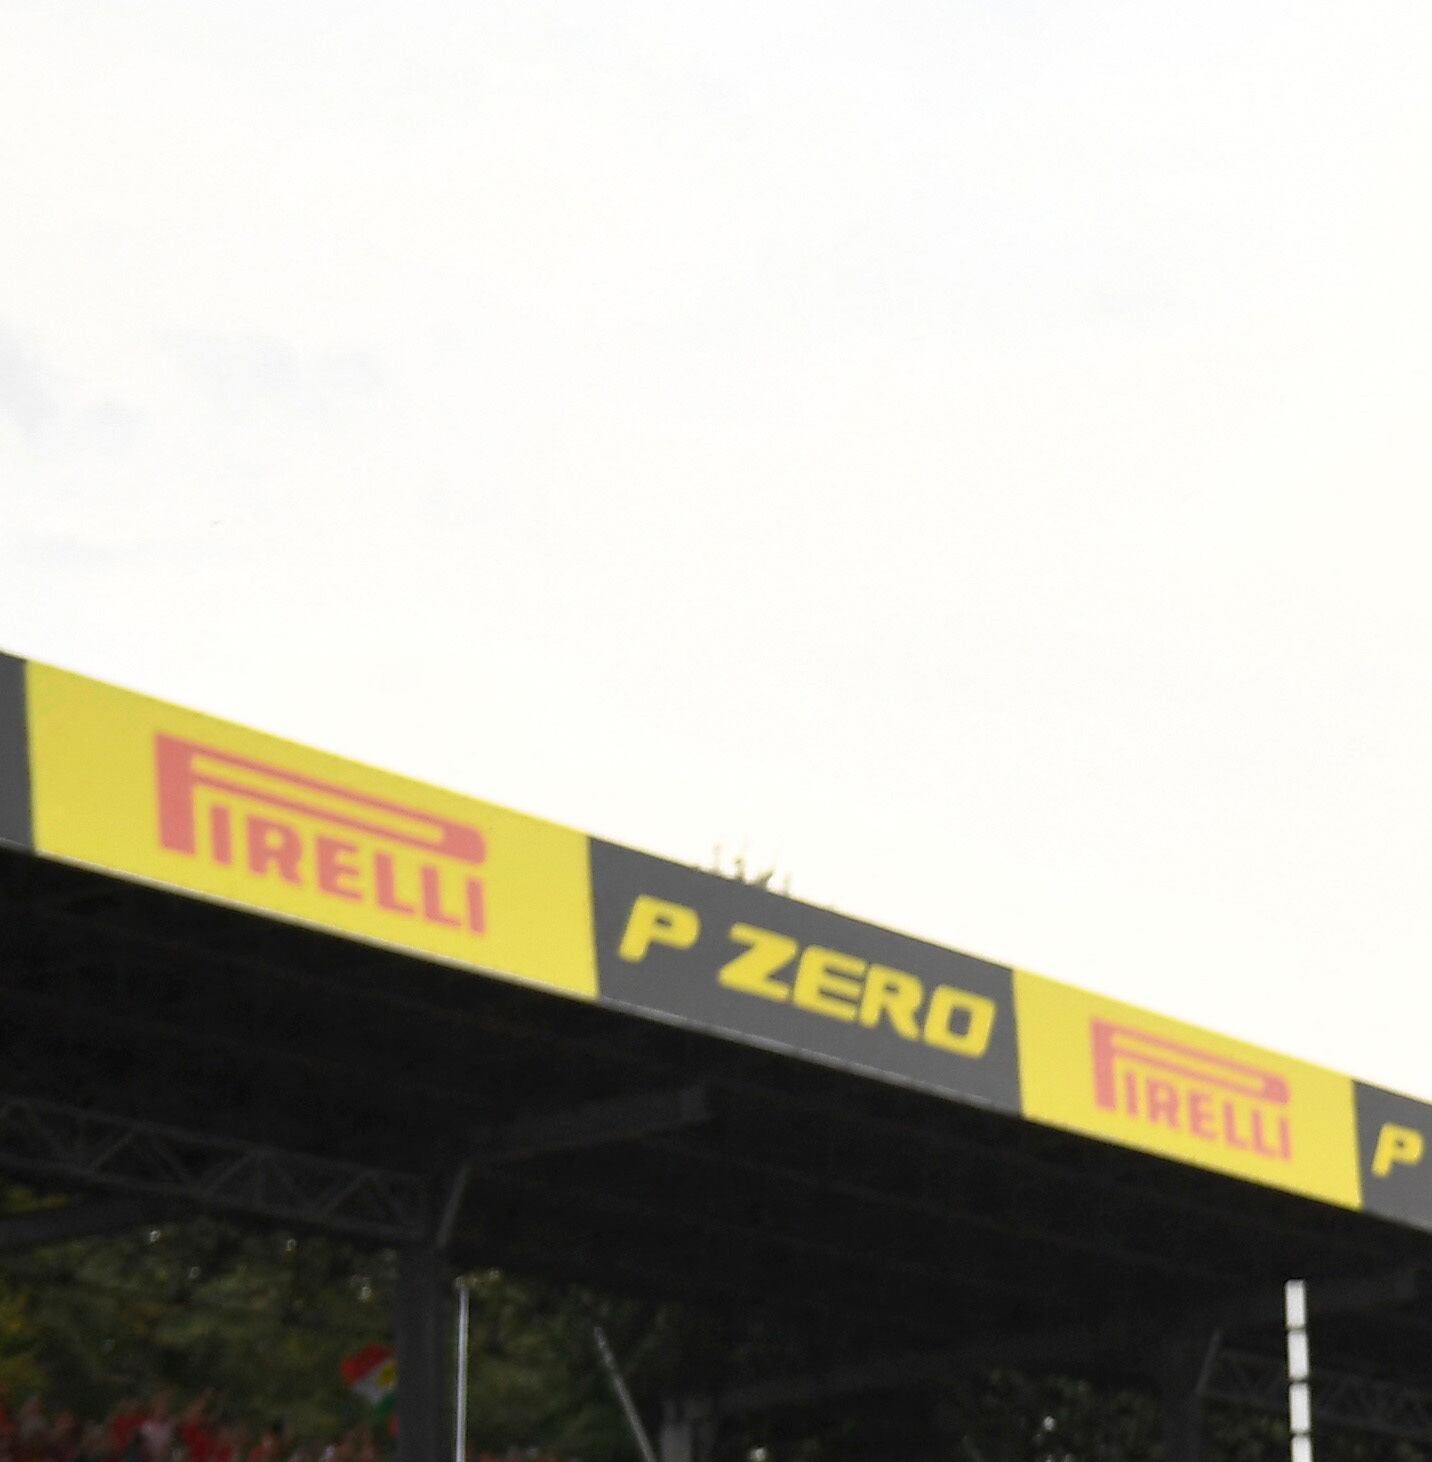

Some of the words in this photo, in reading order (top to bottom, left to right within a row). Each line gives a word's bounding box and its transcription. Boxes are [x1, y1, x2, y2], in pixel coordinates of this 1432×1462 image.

[153, 730, 487, 937] PIRELLI
[618, 893, 704, 961] P
[717, 922, 997, 1058] ZERO
[1090, 1017, 1292, 1161] PIRELLI
[1370, 1121, 1424, 1178] P
